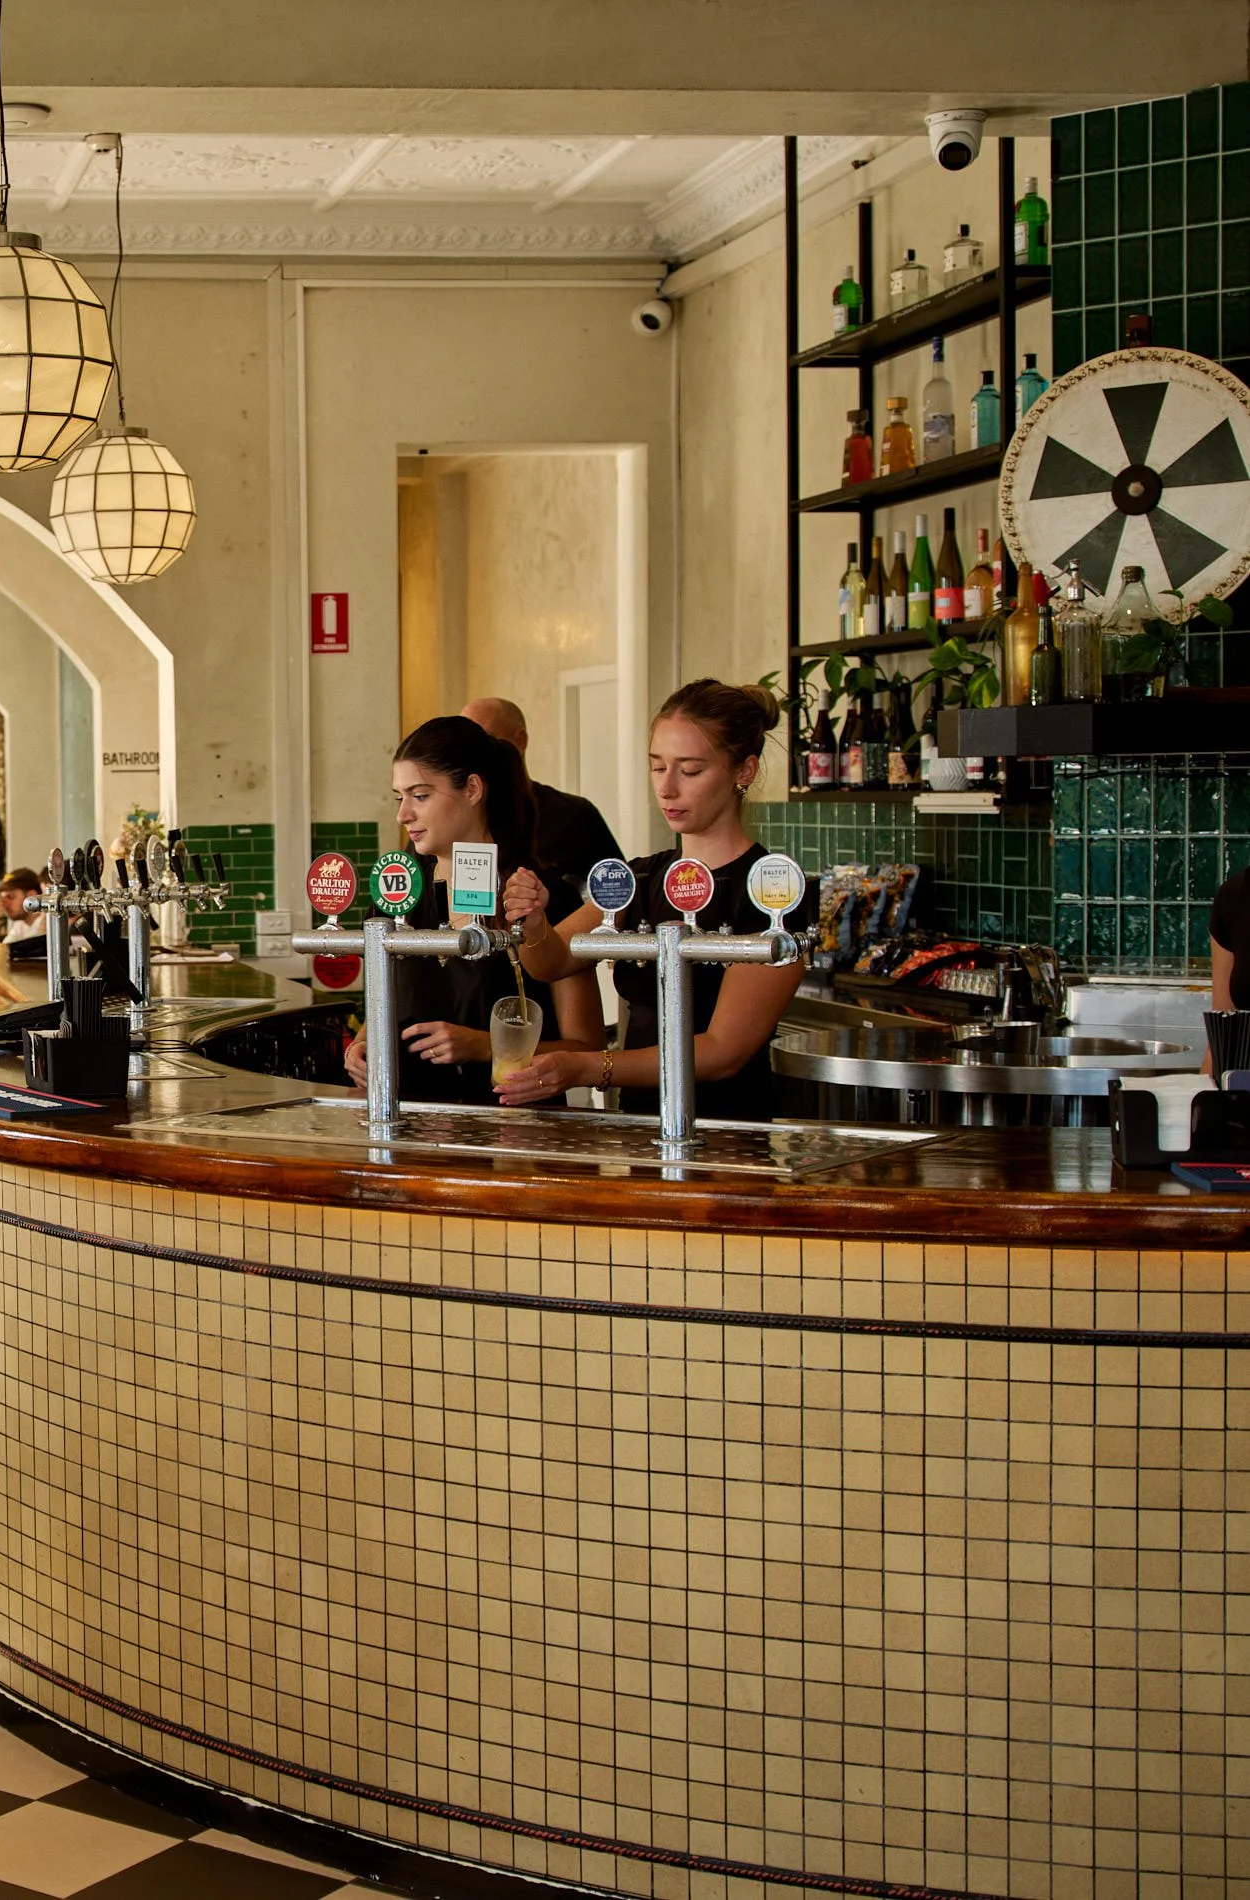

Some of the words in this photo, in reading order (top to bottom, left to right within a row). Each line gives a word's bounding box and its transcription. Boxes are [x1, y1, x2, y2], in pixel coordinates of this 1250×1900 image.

[372, 853, 417, 876] VICTORIA
[458, 858, 489, 866] BALTER
[608, 871, 628, 879] DRY
[310, 878, 351, 889] CARLTON
[382, 875, 408, 892] VB
[671, 883, 706, 893] CARLTON
[311, 887, 350, 897] DRAUGHT
[673, 890, 706, 899] DRAUGHT
[376, 895, 416, 913] BITTER
